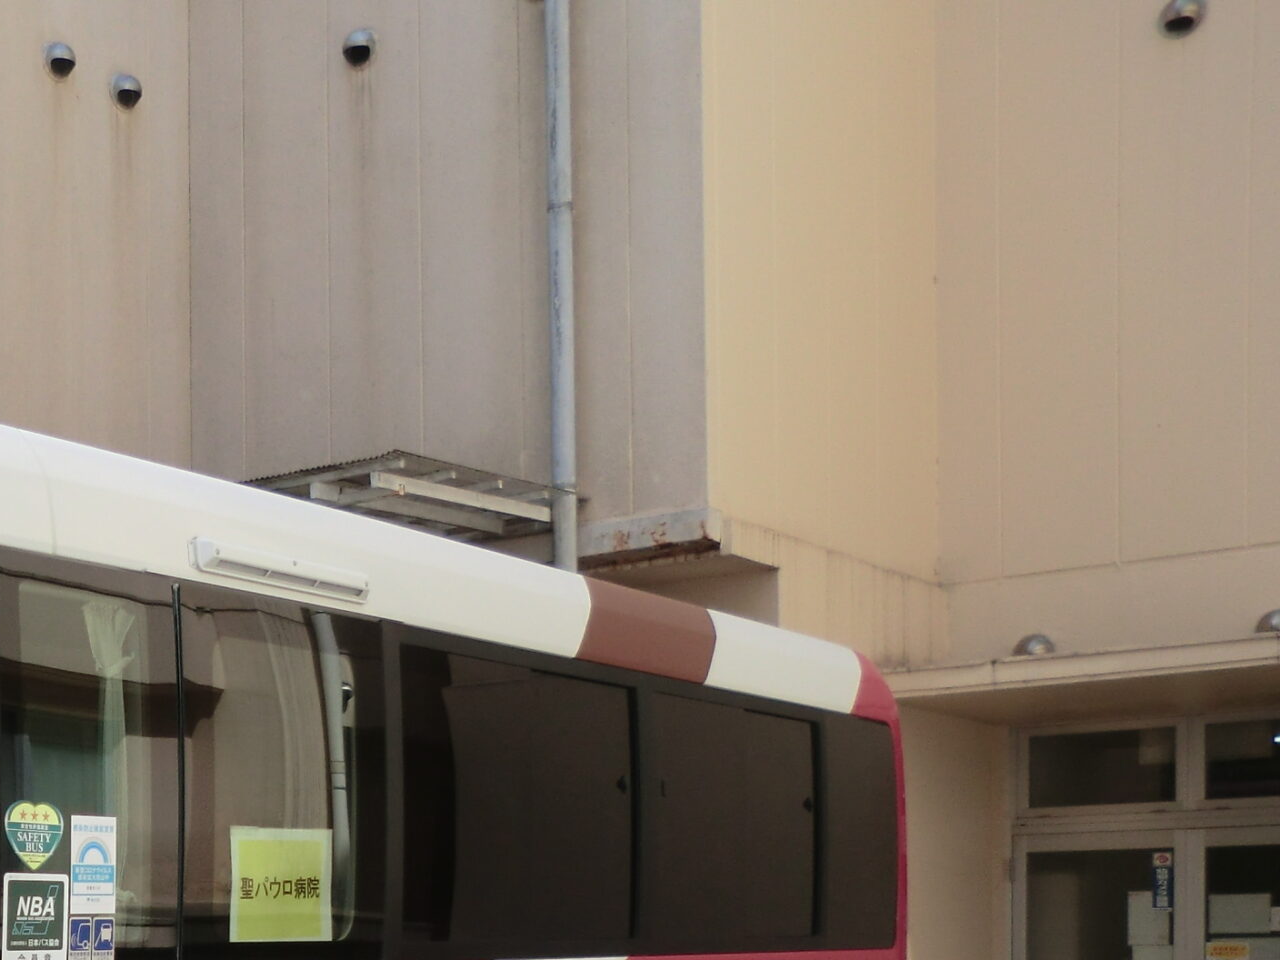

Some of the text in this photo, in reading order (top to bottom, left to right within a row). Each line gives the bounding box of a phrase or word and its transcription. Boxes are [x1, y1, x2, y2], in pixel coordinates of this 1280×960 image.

[17, 831, 51, 843] SAFETY
[25, 842, 44, 853] BUS
[240, 876, 320, 900] 聖パウロ病院
[16, 896, 55, 917] NBA
